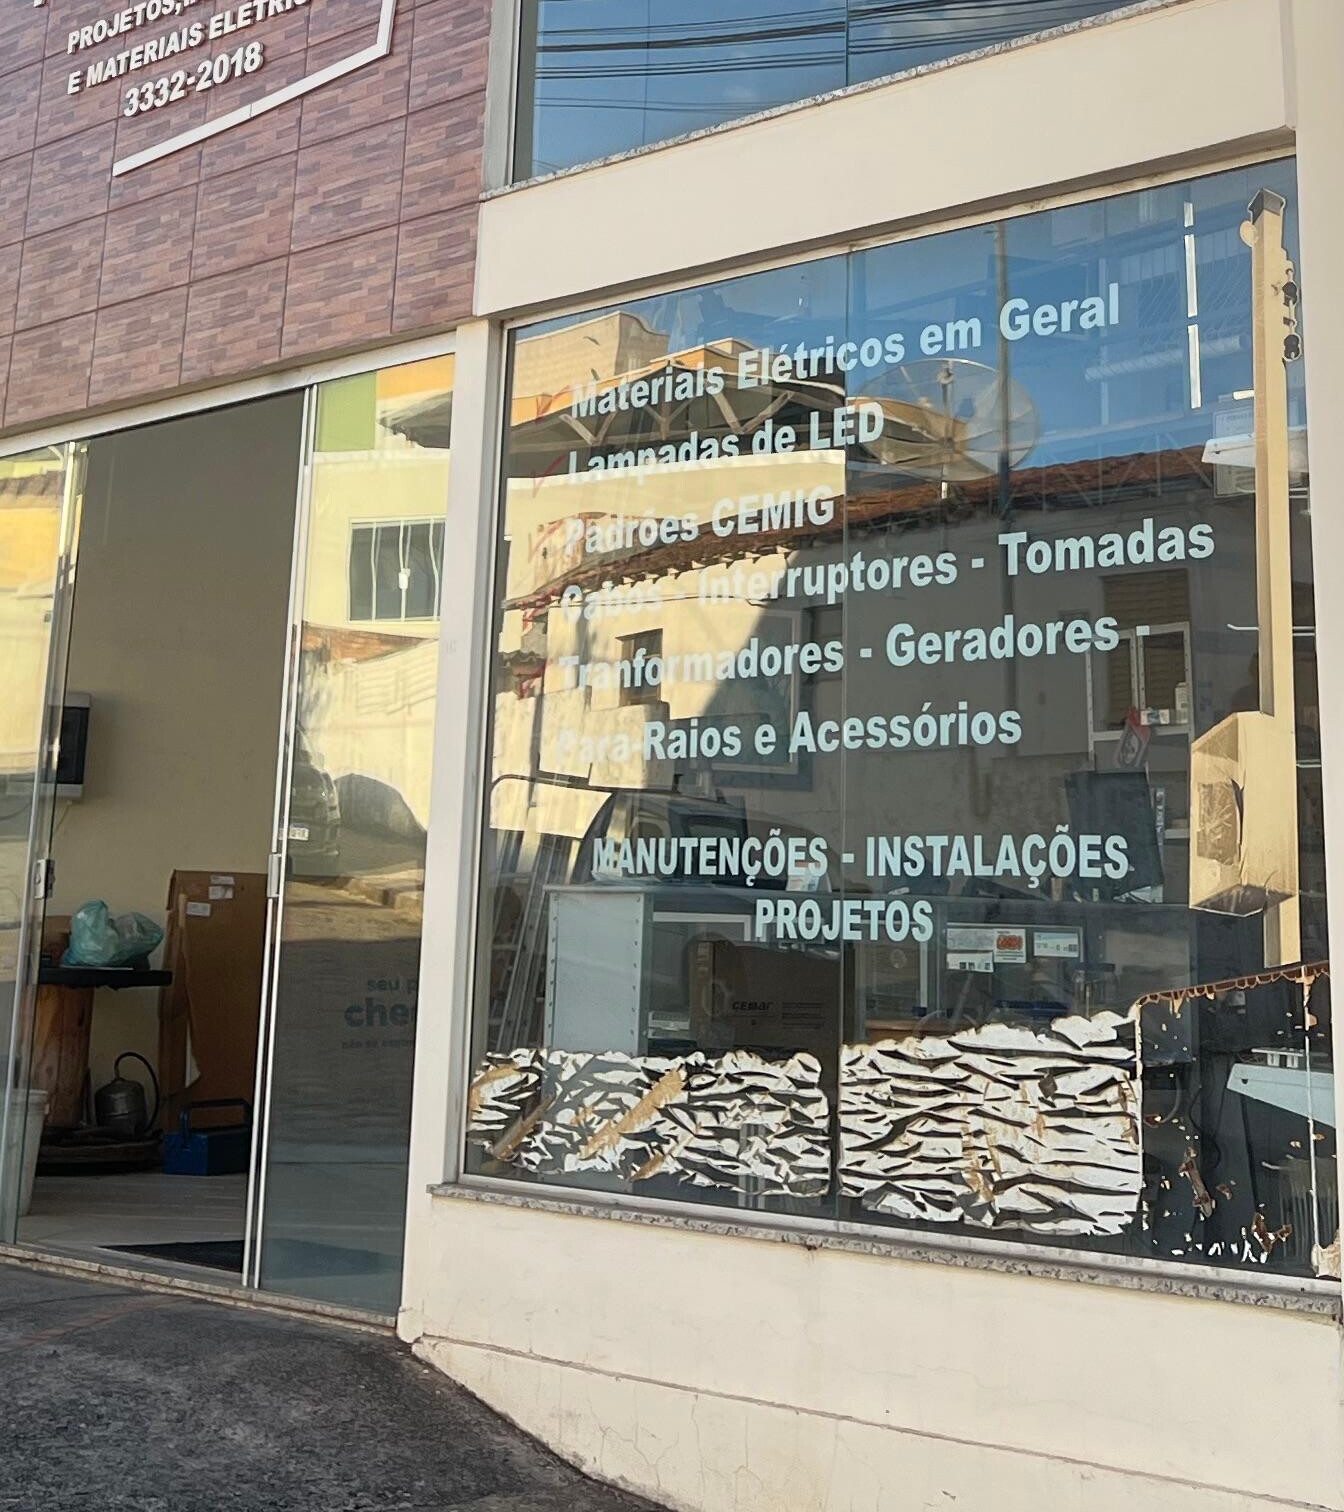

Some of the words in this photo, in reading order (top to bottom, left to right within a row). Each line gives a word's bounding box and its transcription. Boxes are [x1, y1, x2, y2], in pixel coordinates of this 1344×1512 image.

[67, 71, 82, 95] E
[86, 22, 204, 87] MATERIAIS
[123, 41, 264, 117] 3332-2018
[570, 362, 725, 419] Materiais
[737, 331, 906, 390] Elétricos
[919, 316, 982, 355] em
[999, 282, 1119, 341] Geral
[751, 418, 796, 454] de
[809, 400, 885, 451] LED
[711, 483, 835, 538] CEMIG
[697, 551, 958, 606] Interruptores
[997, 518, 1215, 576] Tomadas
[557, 637, 844, 690] Tranformadores
[885, 614, 1119, 667] Geradores
[555, 717, 742, 764] Para-Raios
[754, 723, 777, 756] e
[788, 700, 1023, 754] Acessórios
[591, 828, 828, 887] MANUTENÇÕES
[865, 825, 1130, 889] INSTALAÇÕES
[755, 898, 934, 942] PROJETOS
